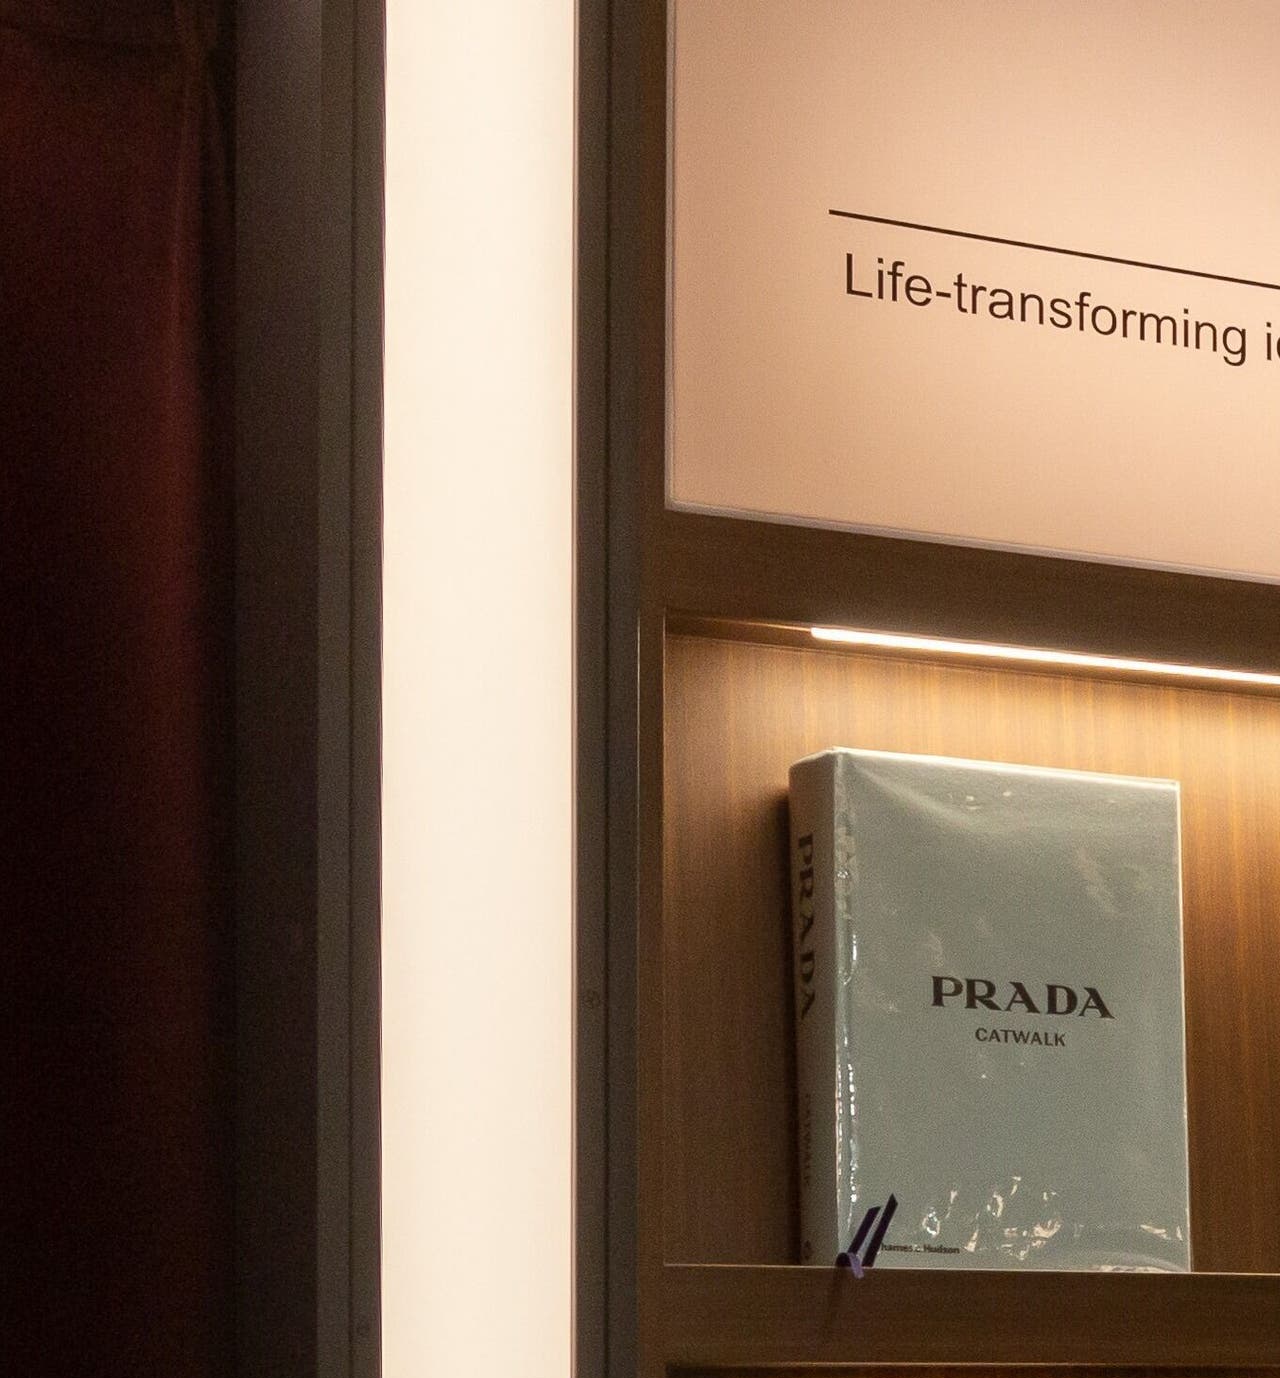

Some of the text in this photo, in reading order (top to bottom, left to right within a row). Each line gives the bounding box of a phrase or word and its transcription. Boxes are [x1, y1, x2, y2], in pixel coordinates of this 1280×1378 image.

[844, 252, 1247, 366] Life-transforming
[797, 833, 815, 1021] PRADA
[930, 975, 1116, 1020] PRADA
[974, 1026, 1066, 1048] CATWALK
[881, 1243, 912, 1253] hames
